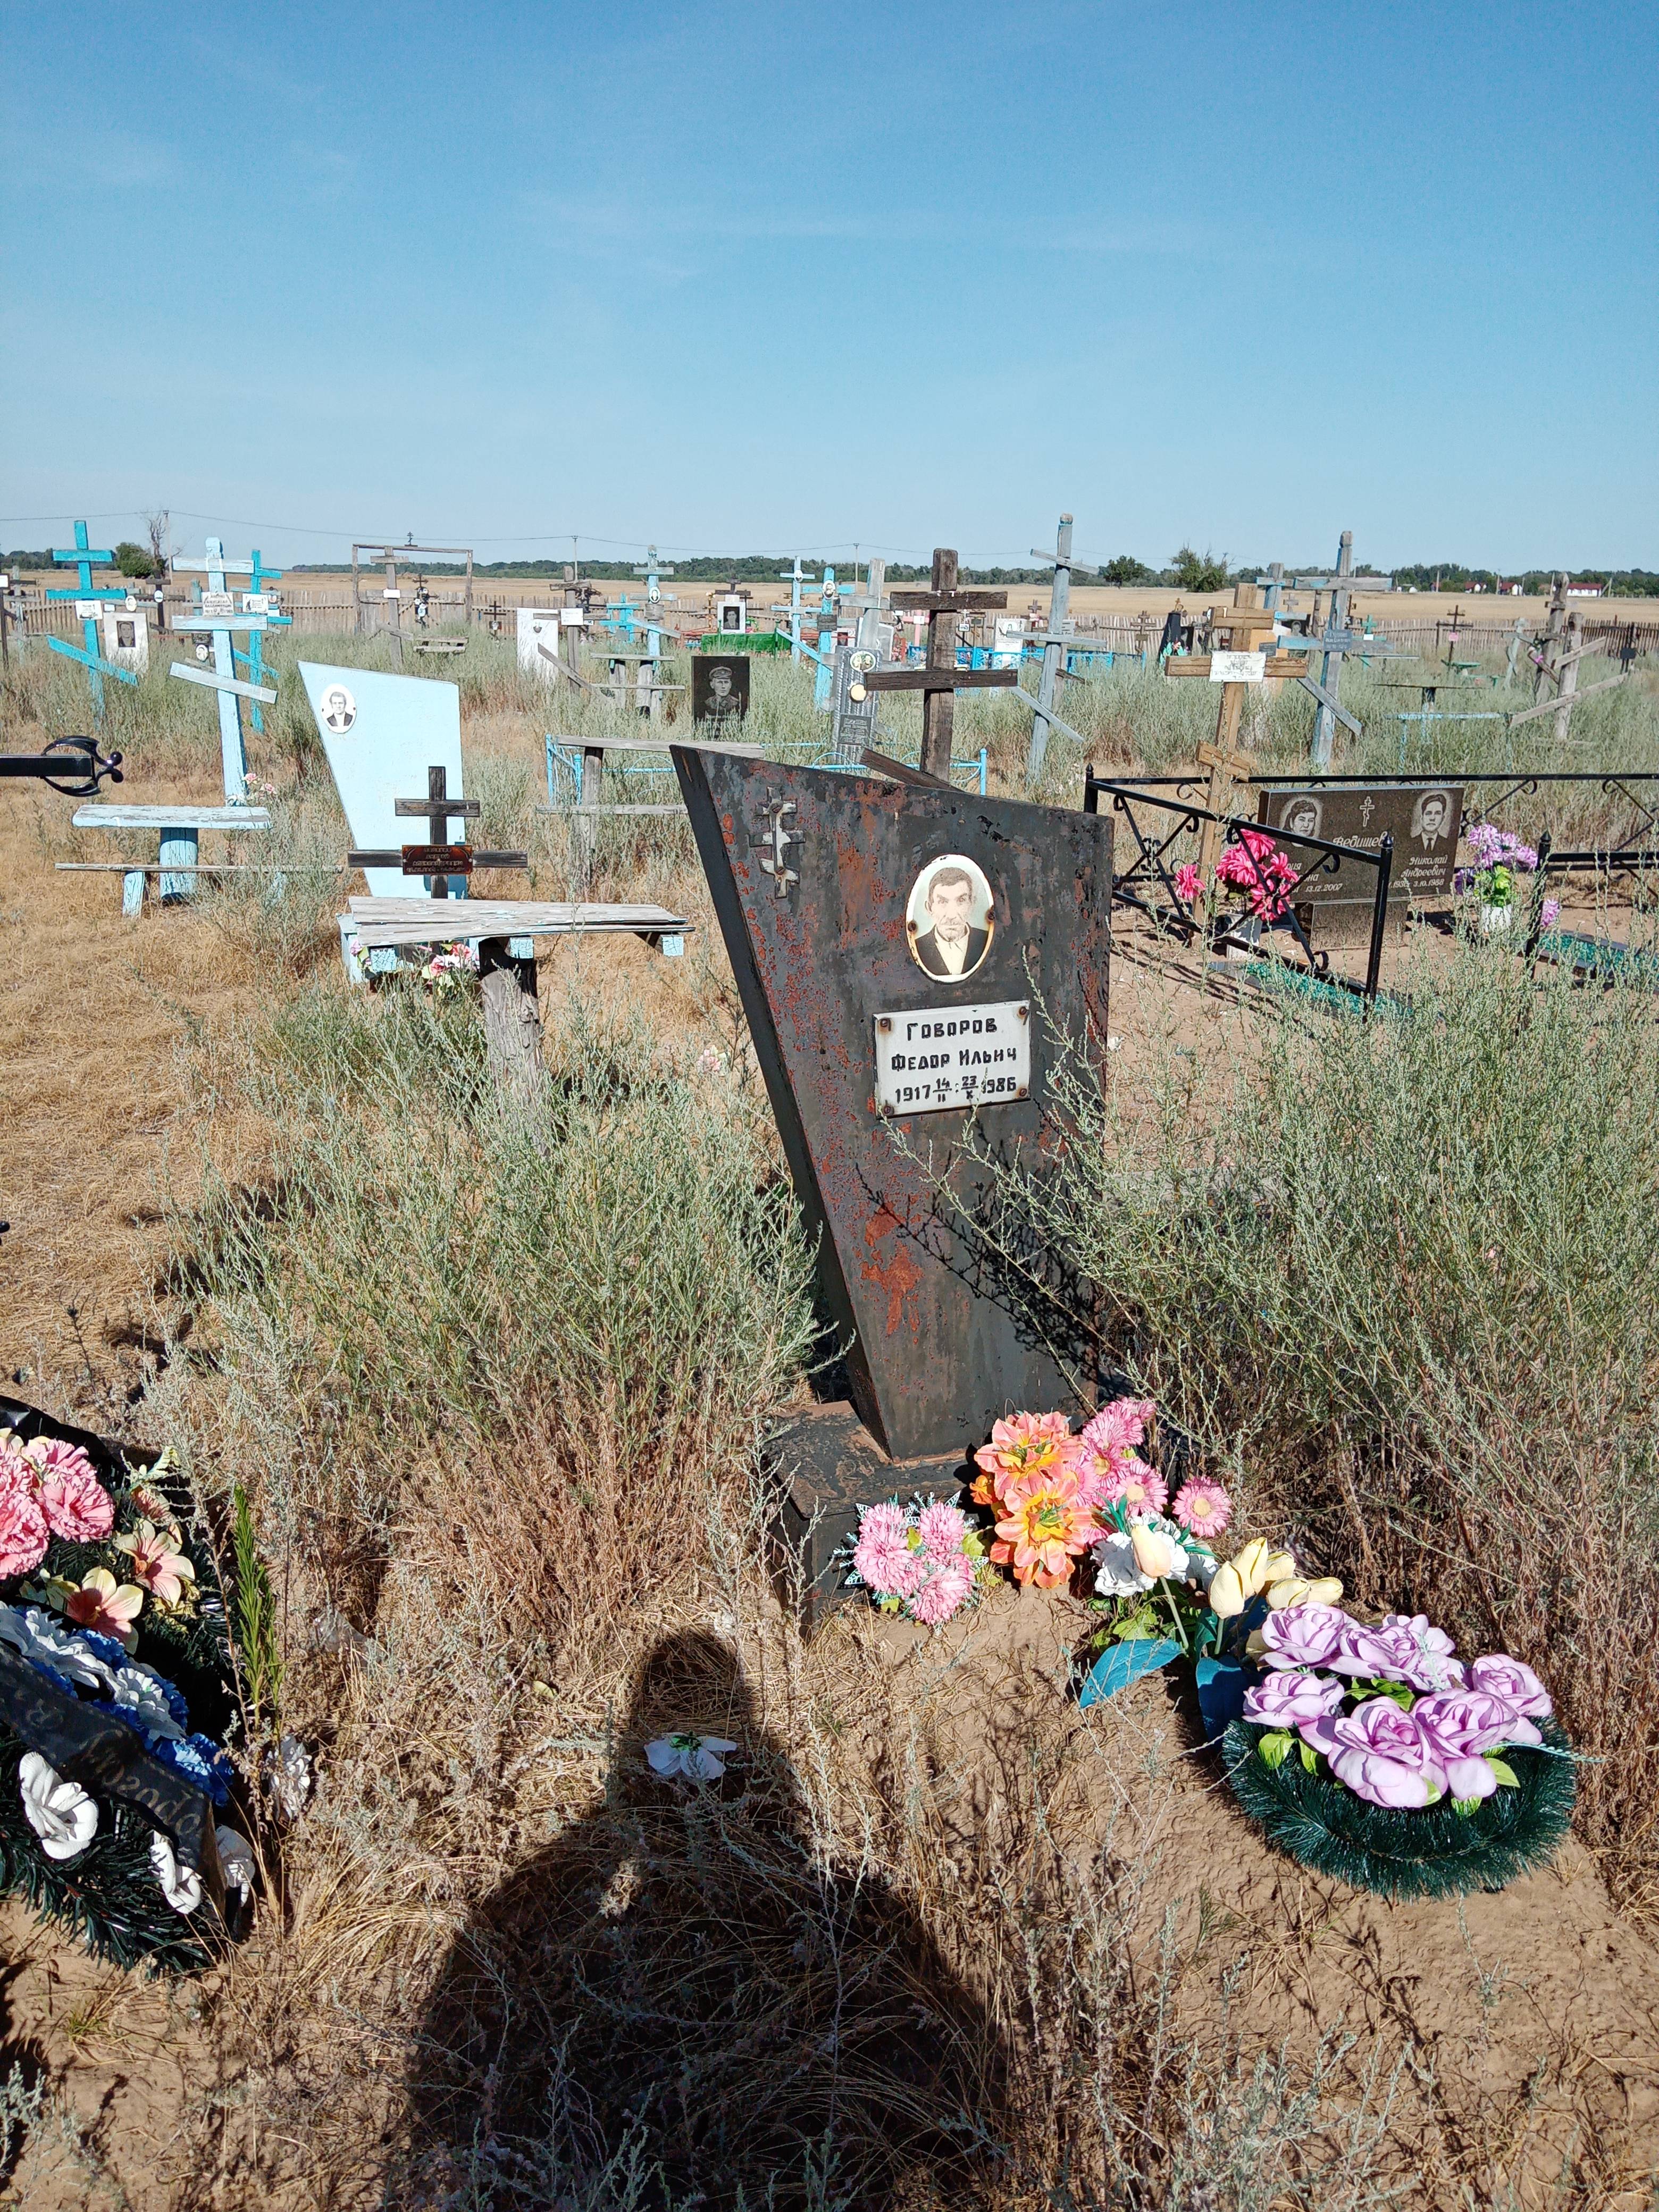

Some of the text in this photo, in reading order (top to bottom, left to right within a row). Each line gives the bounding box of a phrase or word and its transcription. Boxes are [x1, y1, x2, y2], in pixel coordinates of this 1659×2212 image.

[1409, 854, 1448, 865] Николай
[1401, 865, 1446, 877] Андреевич
[1305, 883, 1343, 892] 13.12.2007
[1413, 878, 1445, 887] 3.10.1988
[891, 1048, 1017, 1071] ФЕДОР ИЛЬИЧ
[895, 1084, 931, 1103] 1917
[981, 1077, 1017, 1094] 1986
